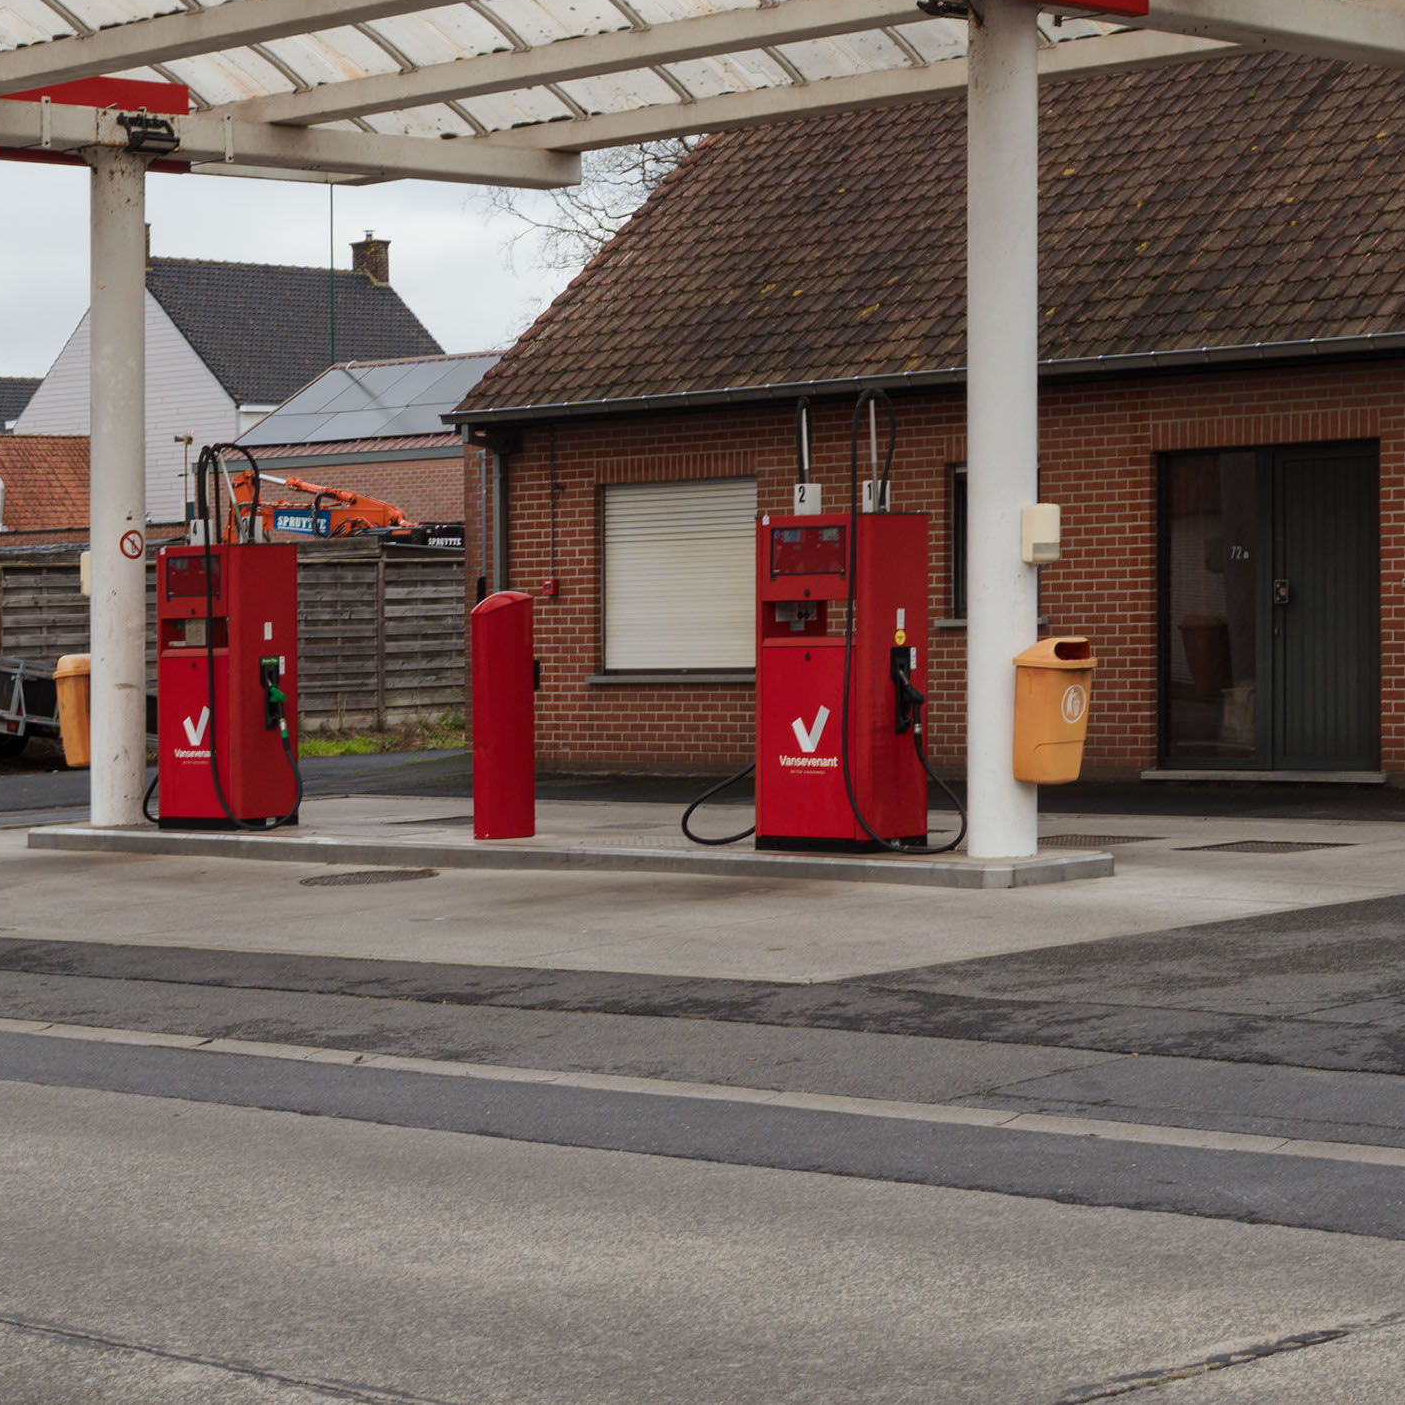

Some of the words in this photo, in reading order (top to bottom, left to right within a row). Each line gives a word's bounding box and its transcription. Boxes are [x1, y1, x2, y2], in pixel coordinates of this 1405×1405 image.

[798, 485, 806, 503] 2
[867, 483, 872, 500] 1
[1230, 545, 1250, 560] 72a
[174, 749, 213, 758] Vansevena
[779, 755, 838, 767] Vansevenant
